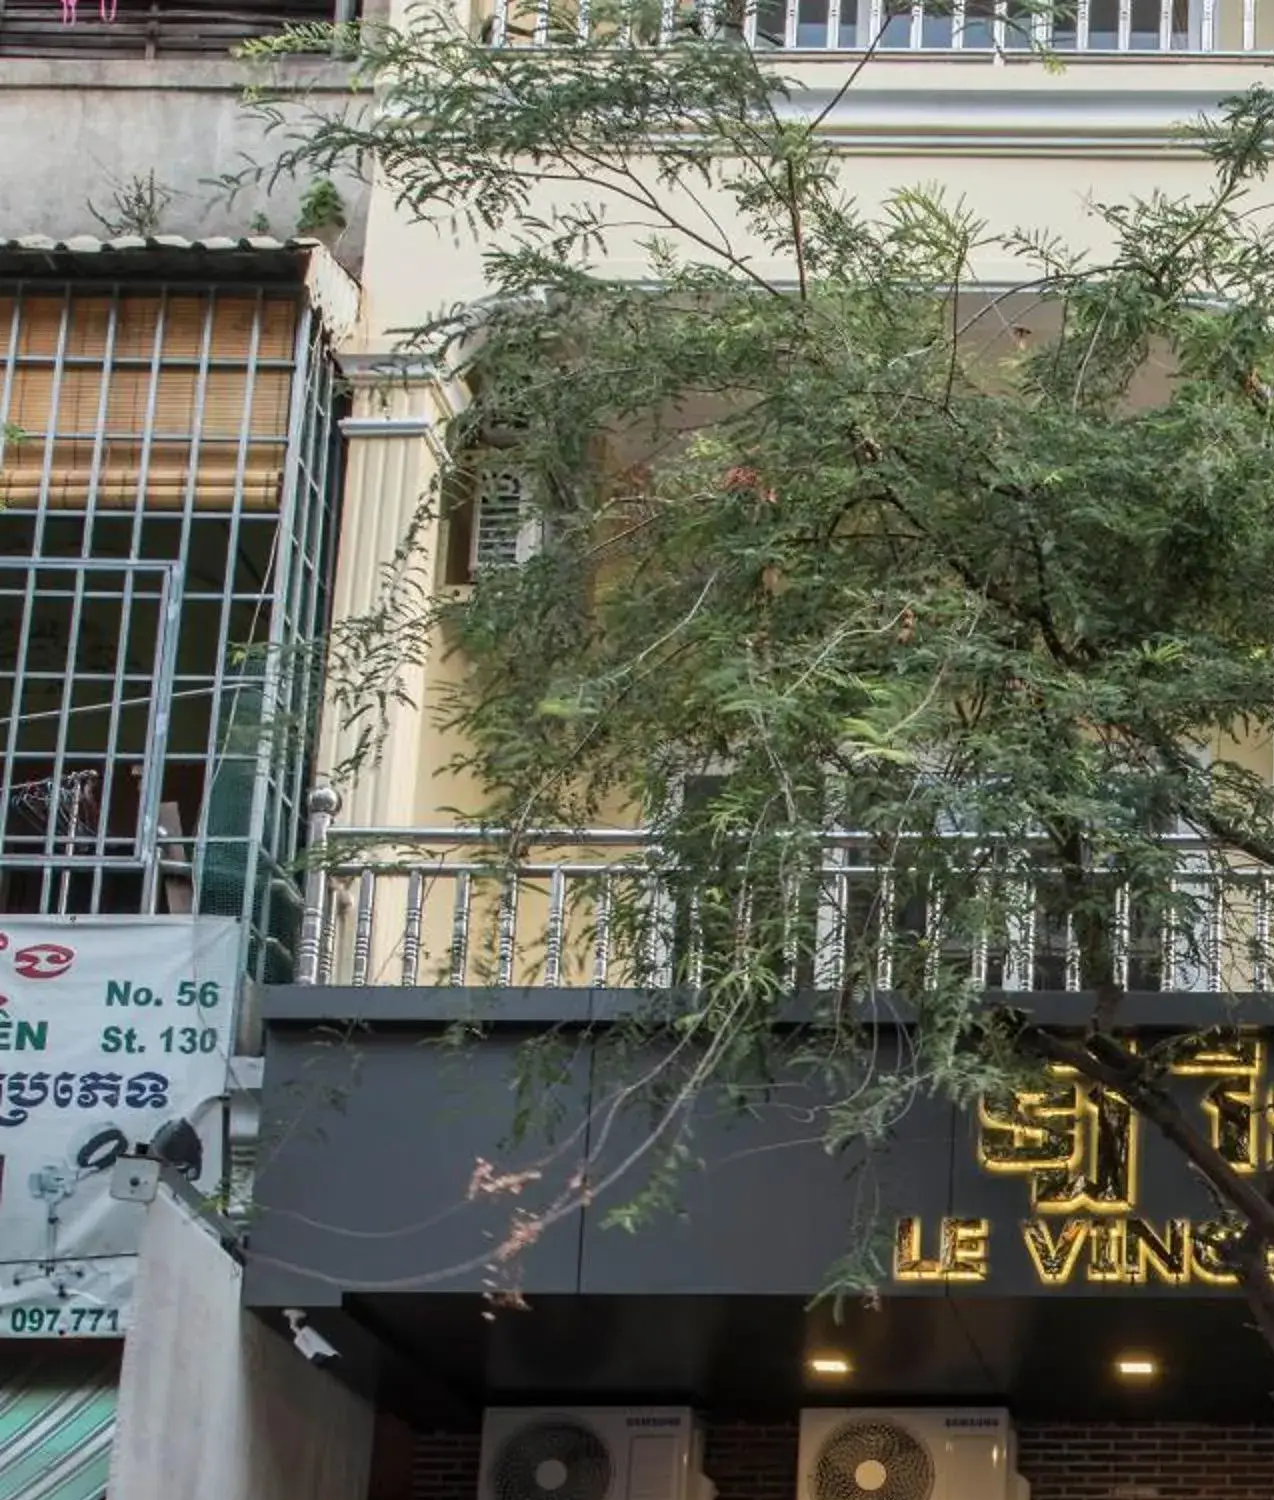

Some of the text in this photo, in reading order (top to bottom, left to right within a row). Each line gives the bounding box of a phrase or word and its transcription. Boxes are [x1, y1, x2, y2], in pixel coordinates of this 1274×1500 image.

[105, 979, 220, 1008] No. 56
[100, 1025, 219, 1054] St. 130
[893, 1216, 989, 1282] LE
